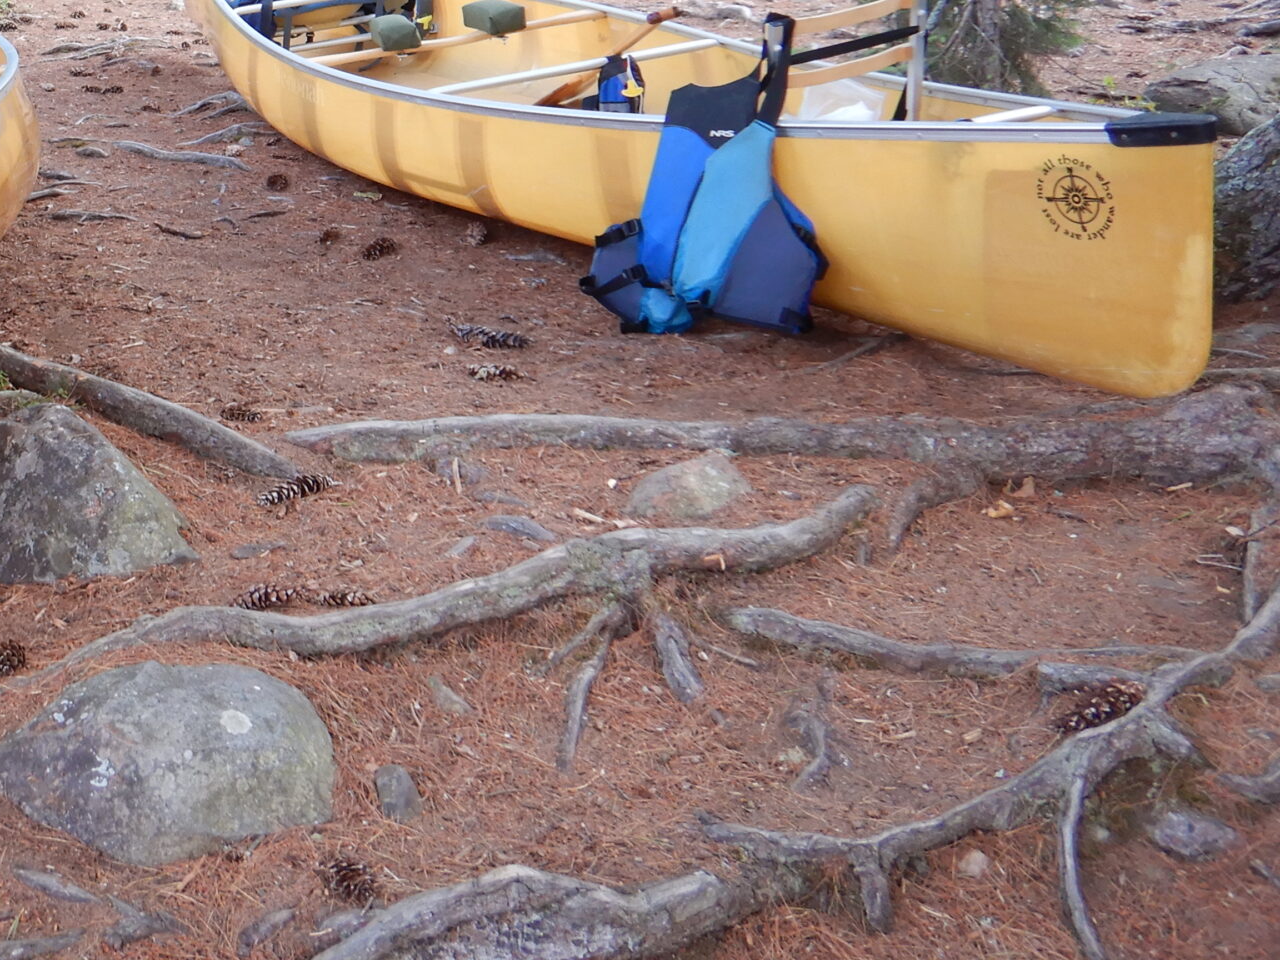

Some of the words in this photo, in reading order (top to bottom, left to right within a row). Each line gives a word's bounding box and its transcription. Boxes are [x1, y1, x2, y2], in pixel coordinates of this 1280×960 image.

[709, 129, 735, 137] NRS
[1043, 158, 1055, 176] all
[1057, 154, 1092, 170] those
[1095, 171, 1113, 200] who
[1041, 208, 1062, 232] lost
[1087, 205, 1116, 241] wander
[1063, 229, 1083, 241] are
